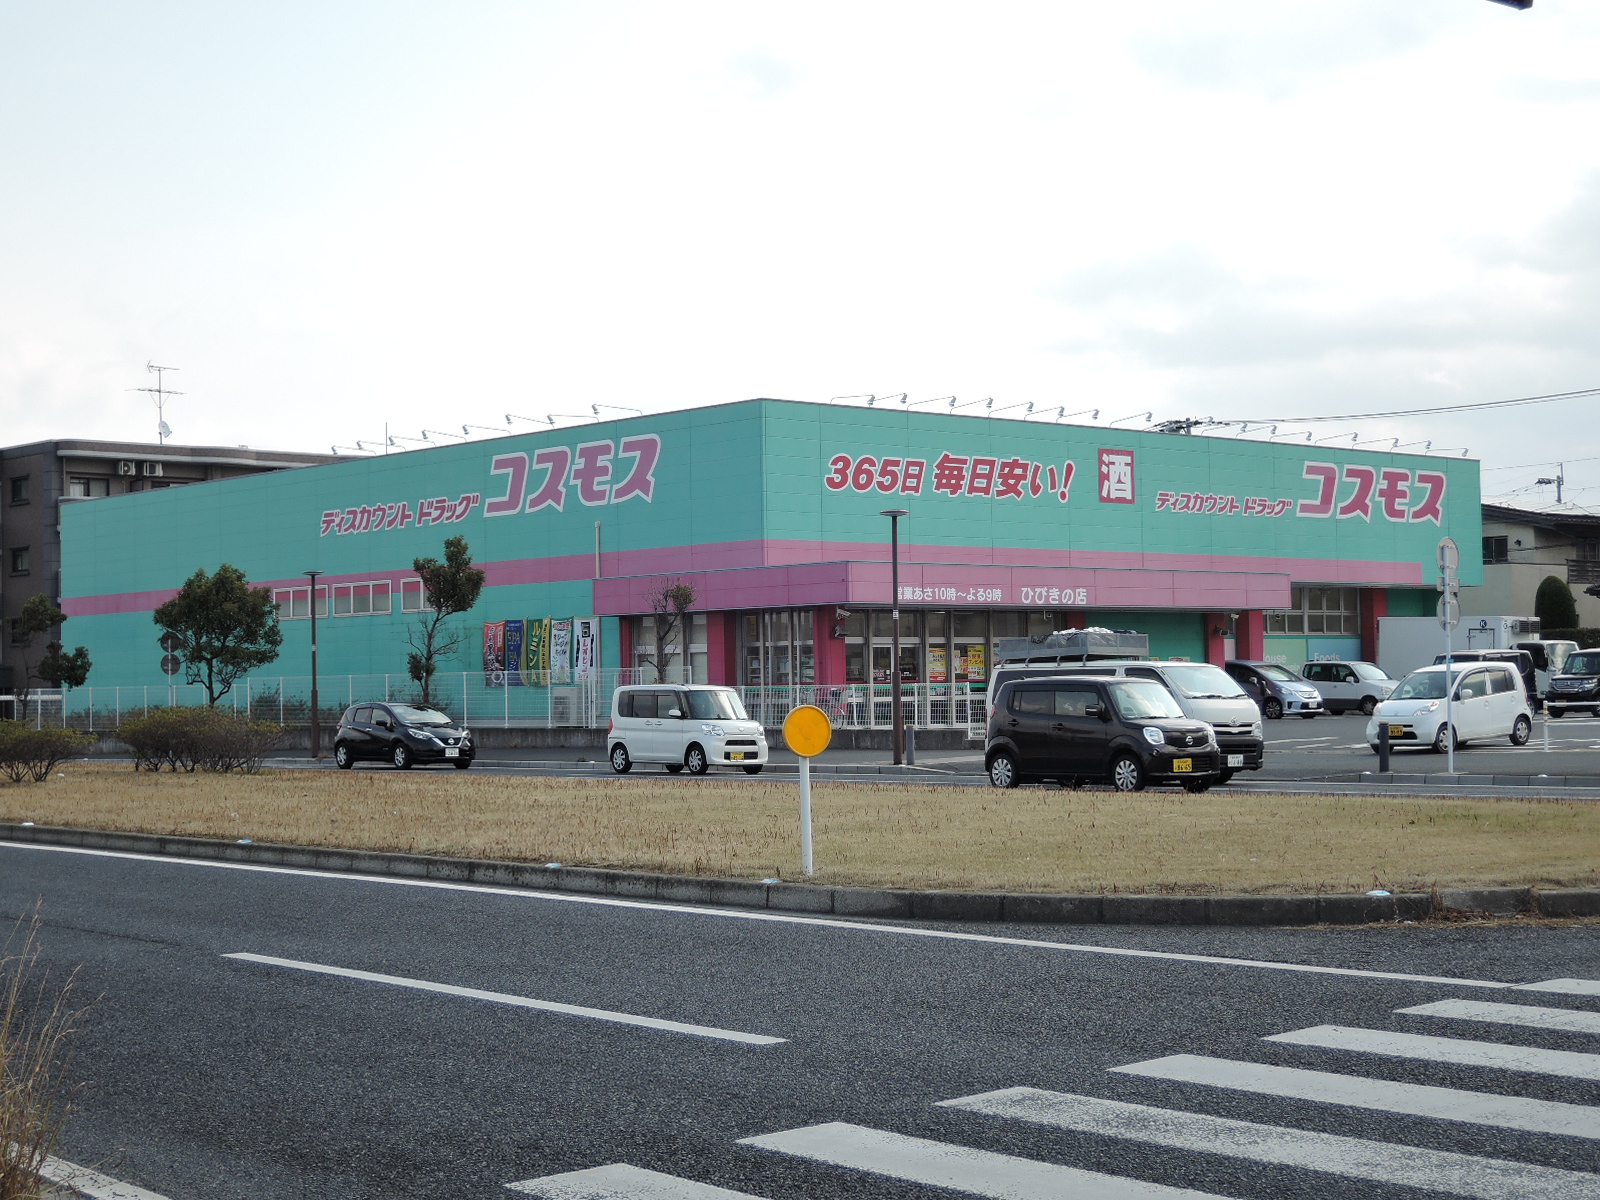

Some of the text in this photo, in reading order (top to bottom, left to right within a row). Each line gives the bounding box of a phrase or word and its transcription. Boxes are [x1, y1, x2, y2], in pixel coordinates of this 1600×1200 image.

[320, 433, 662, 537] ディスカウント ドラッグ コスモス
[824, 451, 1075, 503] 365日 毎日安い!
[1101, 453, 1132, 500] 酒
[1155, 461, 1446, 527] ディスカウント ドラッグ コスモス
[1021, 587, 1087, 605] ひびきの店
[1264, 655, 1287, 663] ouse
